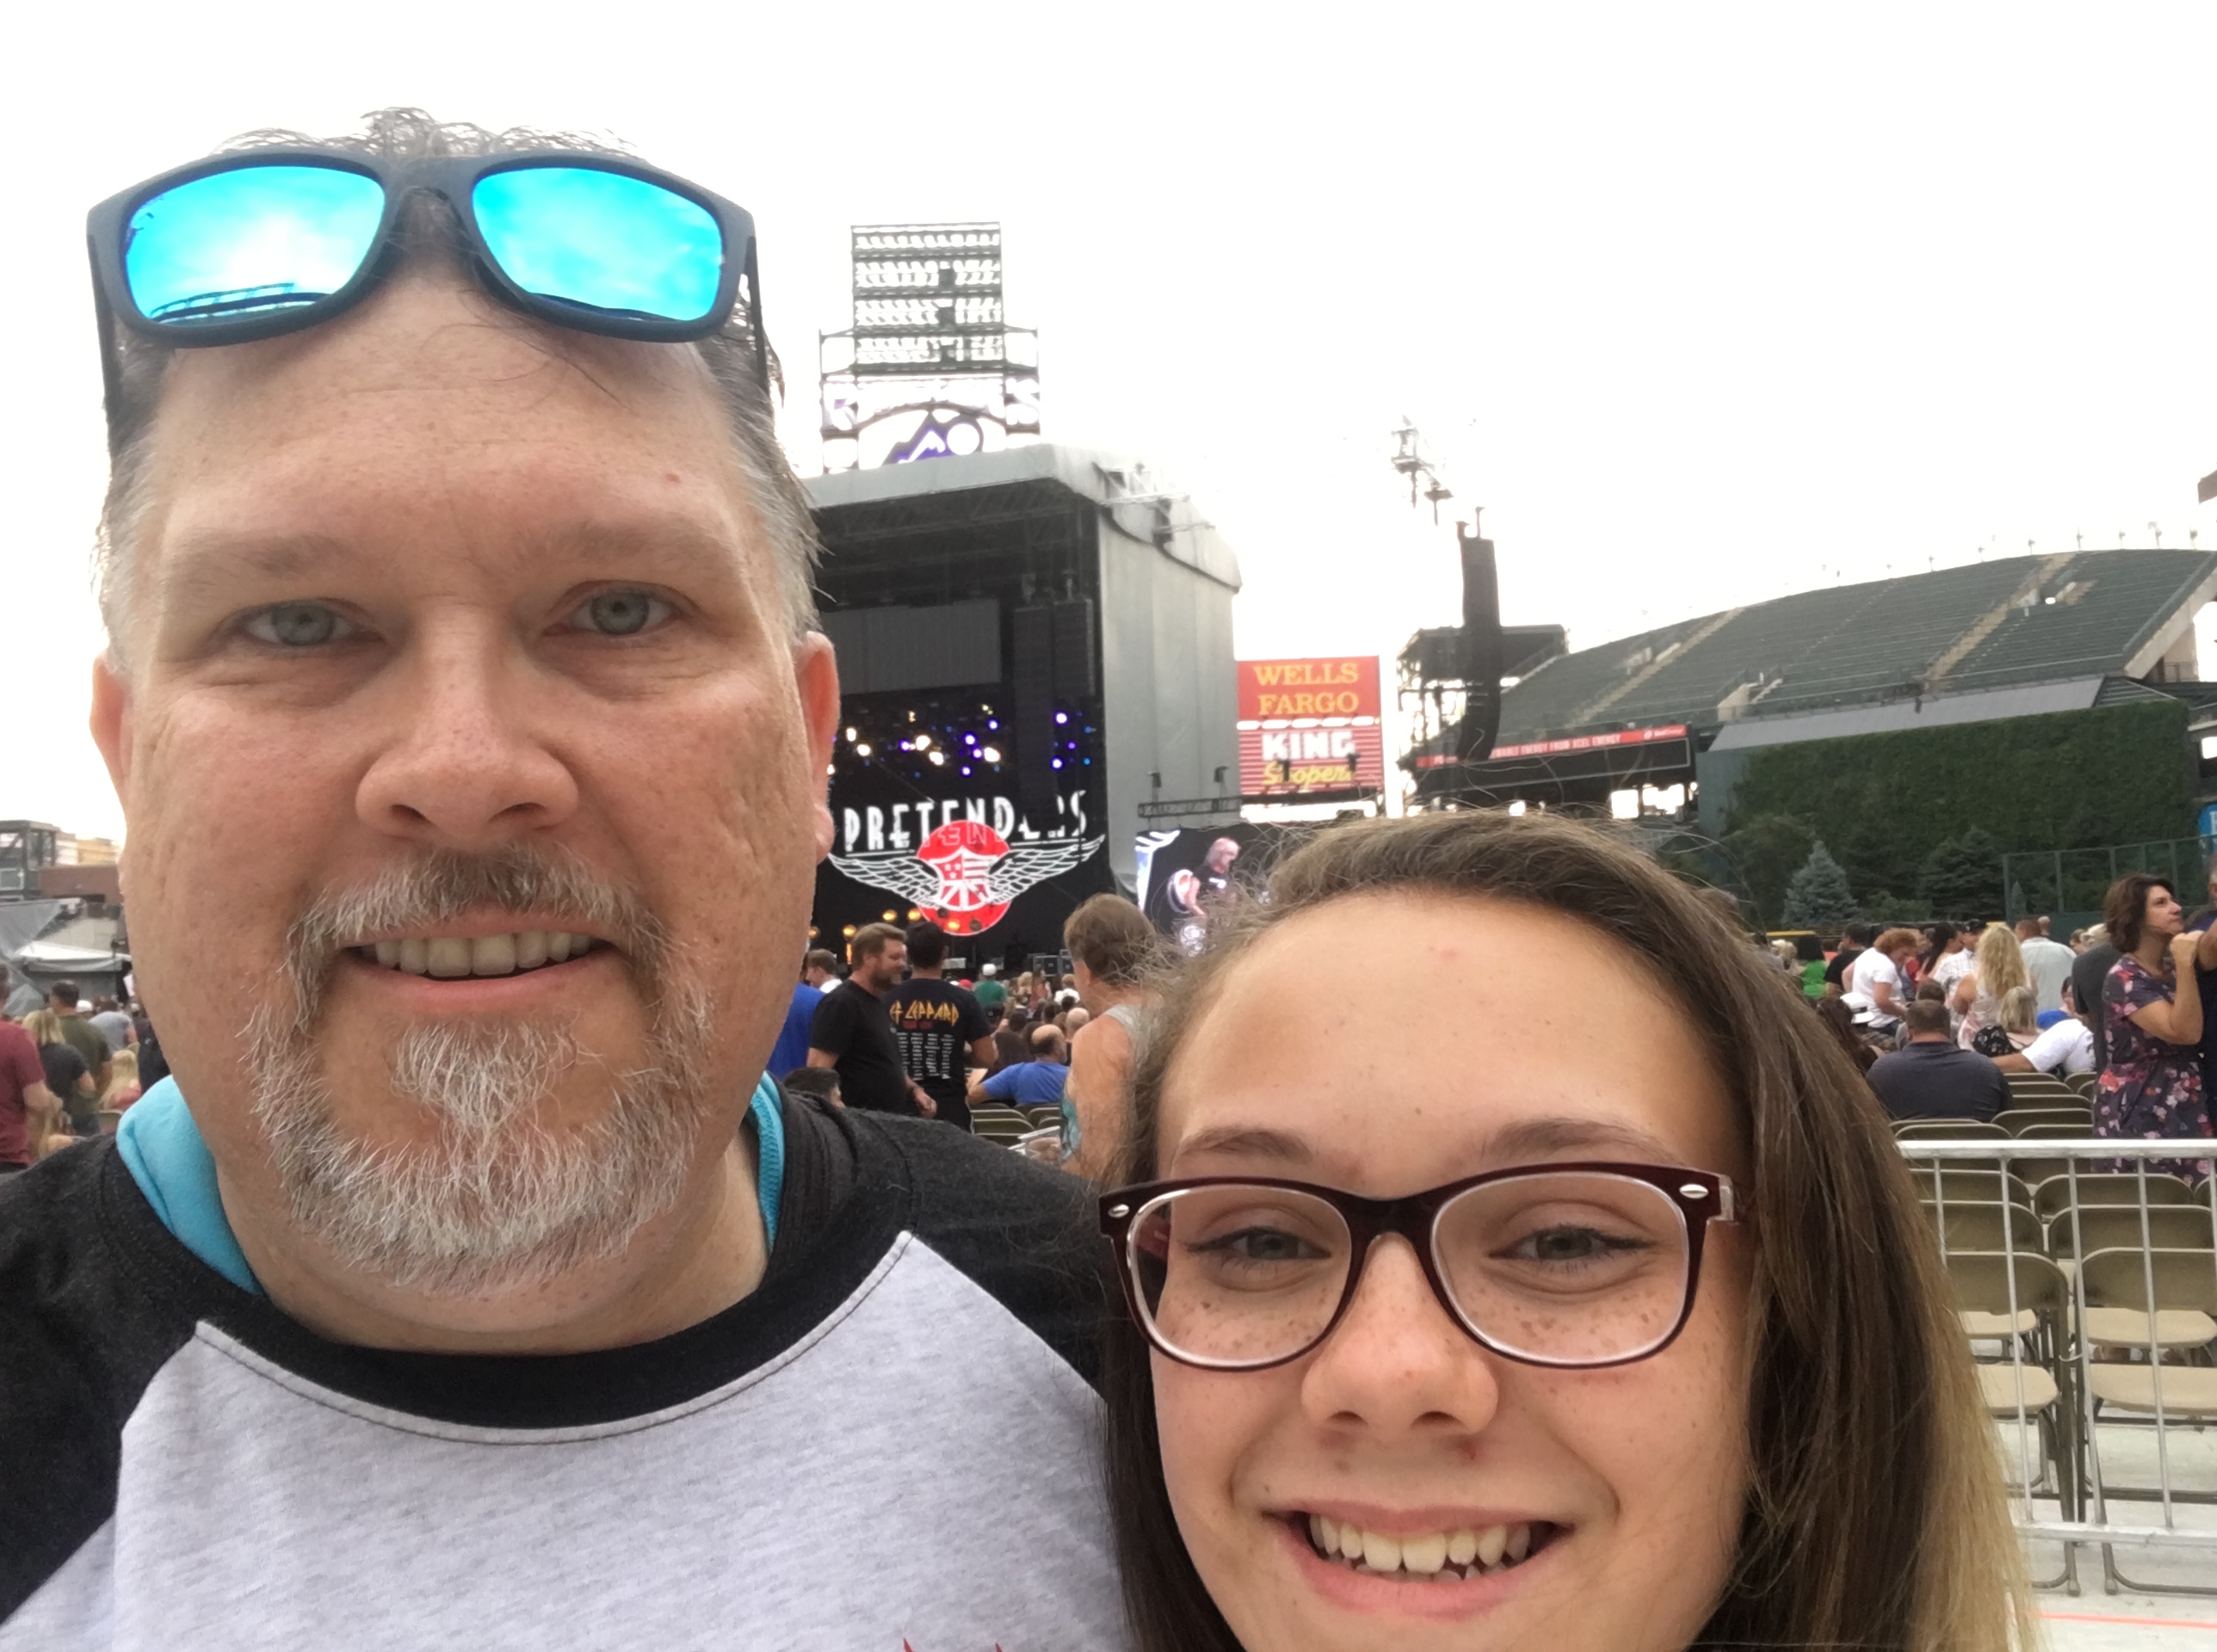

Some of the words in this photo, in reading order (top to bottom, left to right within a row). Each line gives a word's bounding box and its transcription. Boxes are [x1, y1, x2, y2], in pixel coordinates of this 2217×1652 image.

[1253, 662, 1359, 686] WELLS
[1257, 691, 1359, 716] FARGO
[1262, 731, 1355, 761] KING
